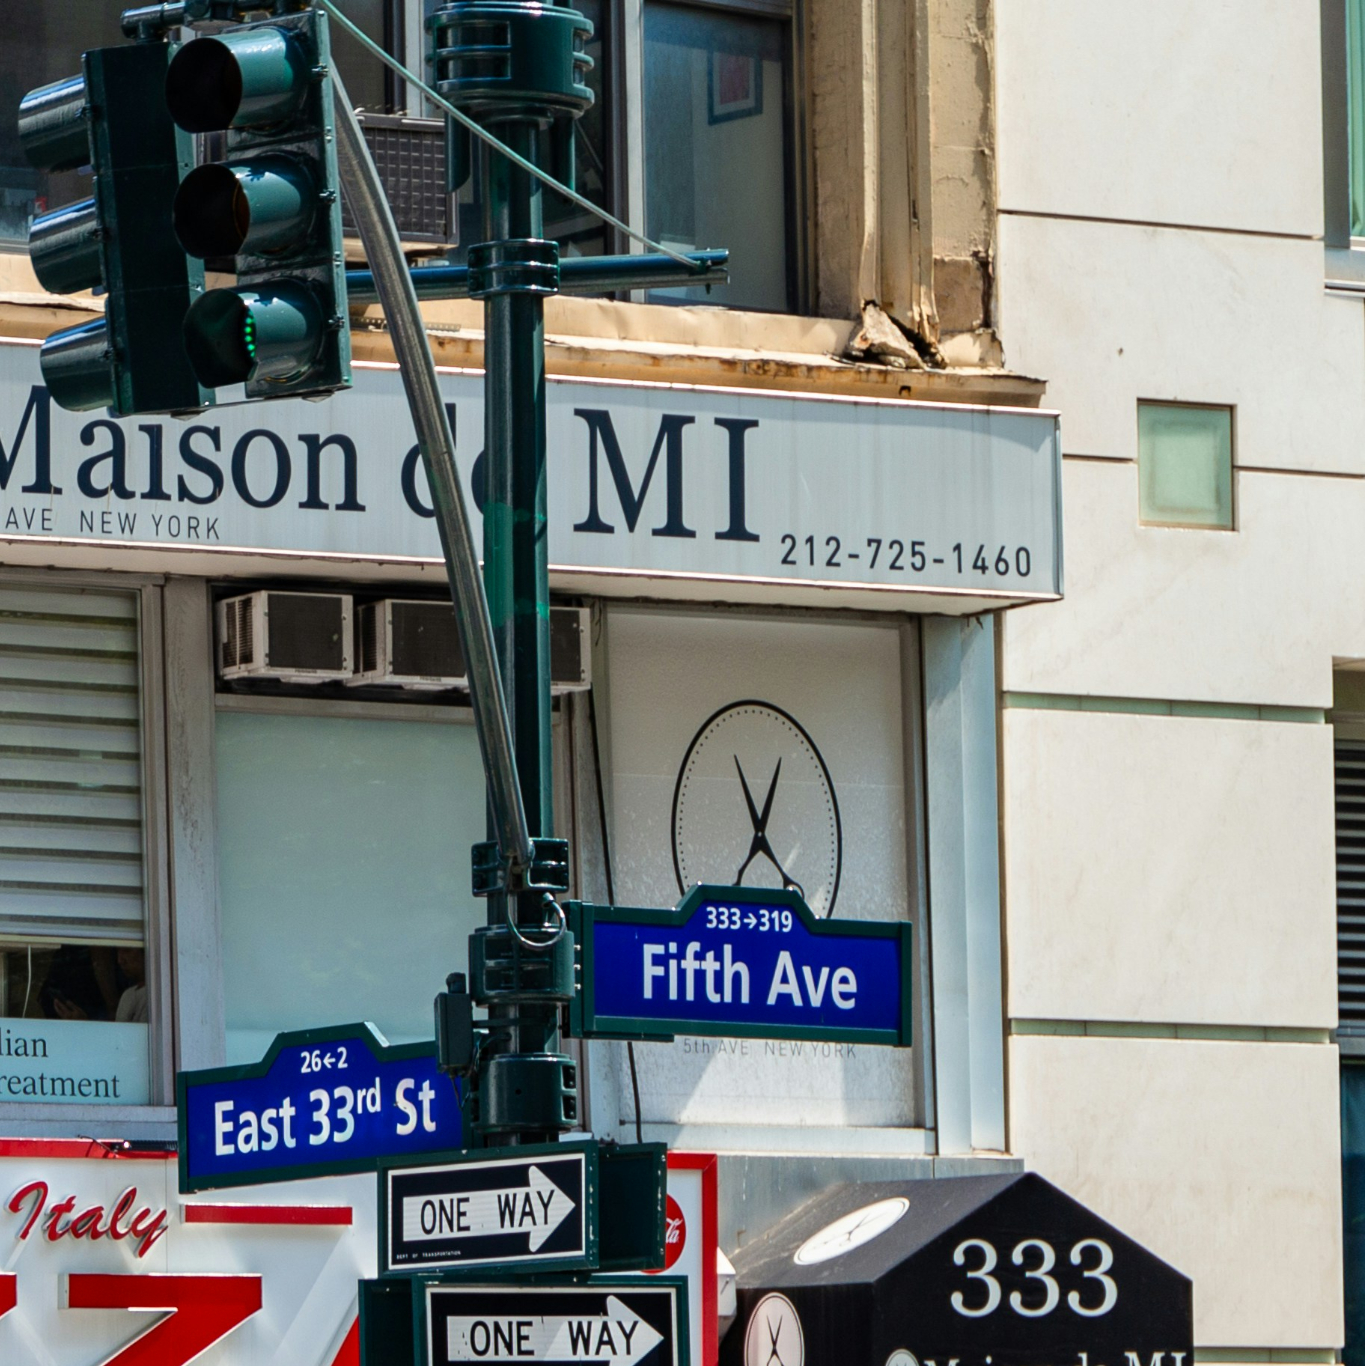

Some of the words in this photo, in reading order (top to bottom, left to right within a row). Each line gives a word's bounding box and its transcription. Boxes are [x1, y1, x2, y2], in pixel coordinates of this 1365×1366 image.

[573, 408, 760, 542] MI
[5, 505, 54, 532] AVE
[80, 509, 137, 536] NEW
[152, 514, 220, 540] YORK
[779, 533, 1032, 579] 212-725-1460
[642, 942, 750, 1003] Fifth
[768, 951, 858, 1009] Ave
[684, 1038, 709, 1055] 5th
[719, 1039, 748, 1056] AVE
[765, 1041, 803, 1057] NEW
[811, 1042, 856, 1059] YORK
[213, 1095, 296, 1157] East
[308, 1077, 381, 1146] 33rd
[396, 1077, 437, 1136] St
[4, 1181, 168, 1260] Italy
[421, 1196, 470, 1235] ONE
[497, 1189, 555, 1229] WAY
[422, 1250, 461, 1258] TRANSPORTATION
[950, 1238, 1118, 1317] 333
[470, 1320, 535, 1356] ONE
[568, 1320, 639, 1356] WAY
